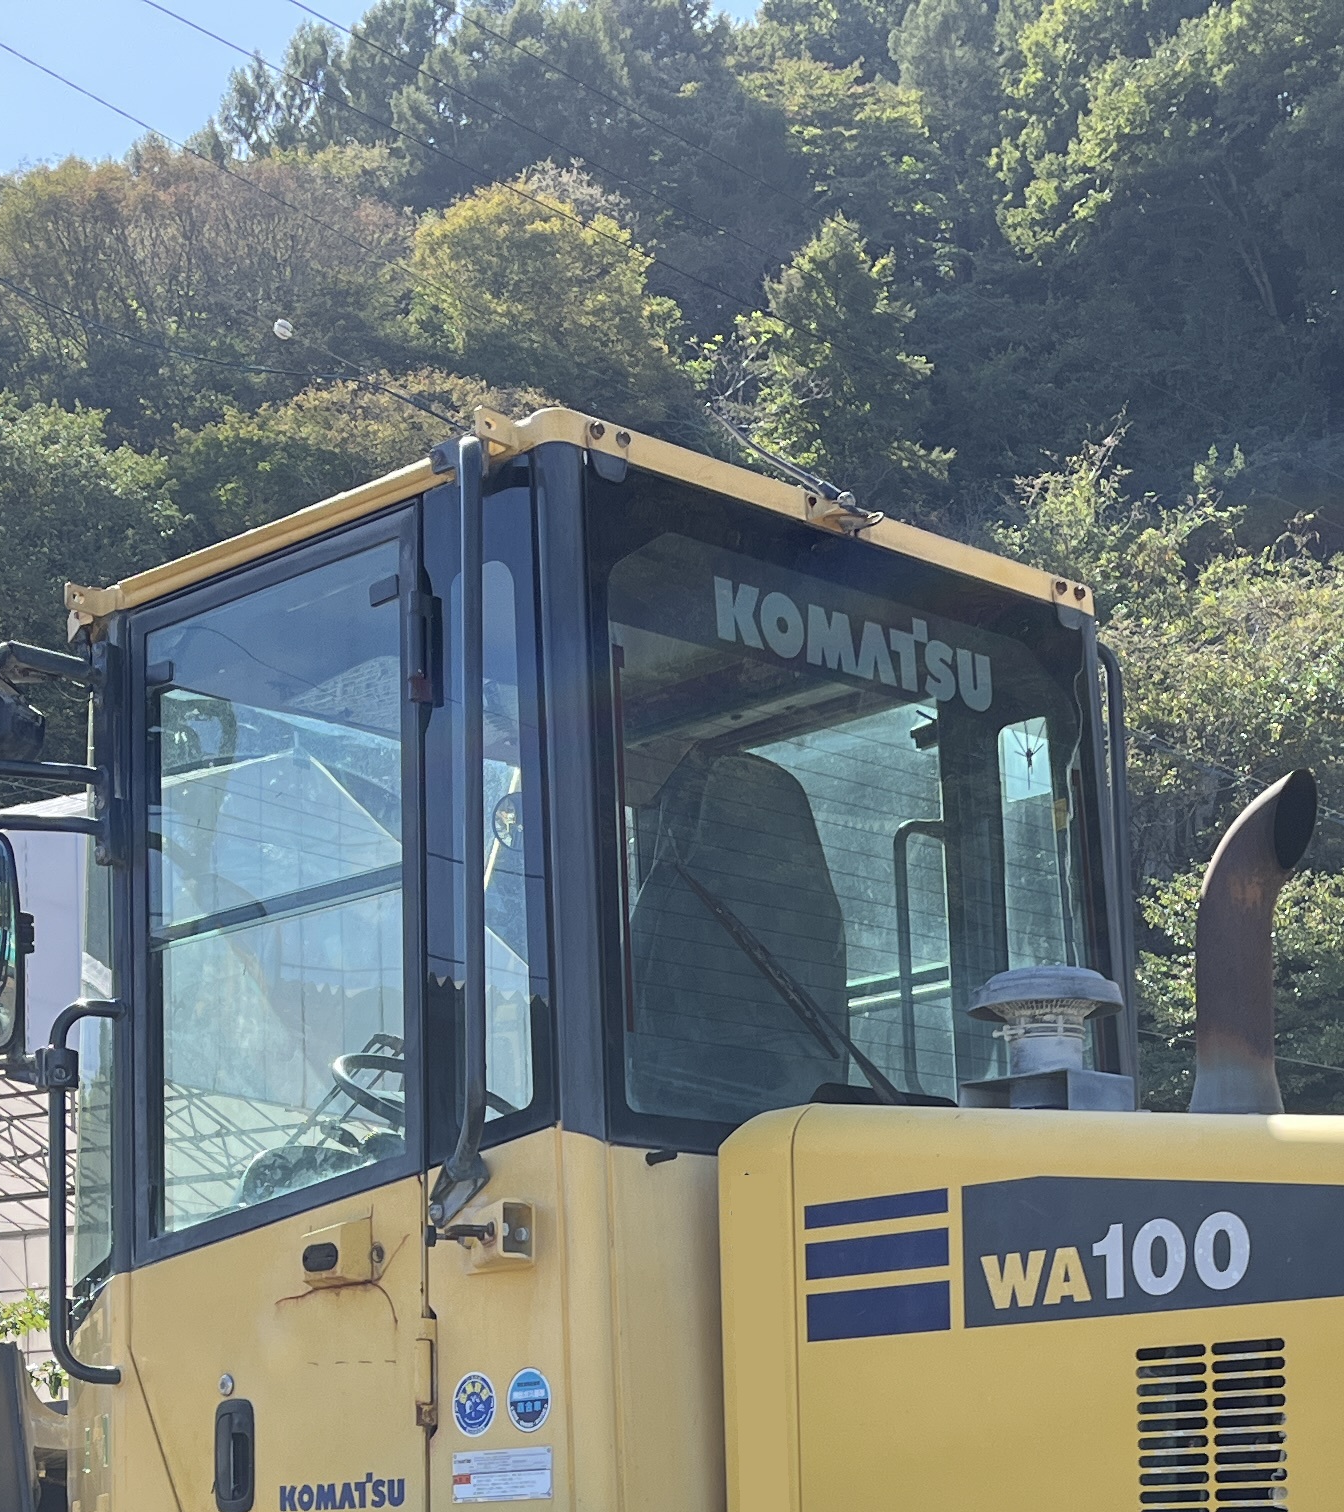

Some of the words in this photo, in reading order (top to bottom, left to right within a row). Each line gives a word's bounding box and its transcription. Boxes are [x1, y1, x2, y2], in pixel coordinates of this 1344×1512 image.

[714, 575, 993, 712] KOMATSU
[980, 1210, 1251, 1311] WA100
[279, 1472, 405, 1511] KOMATSU
